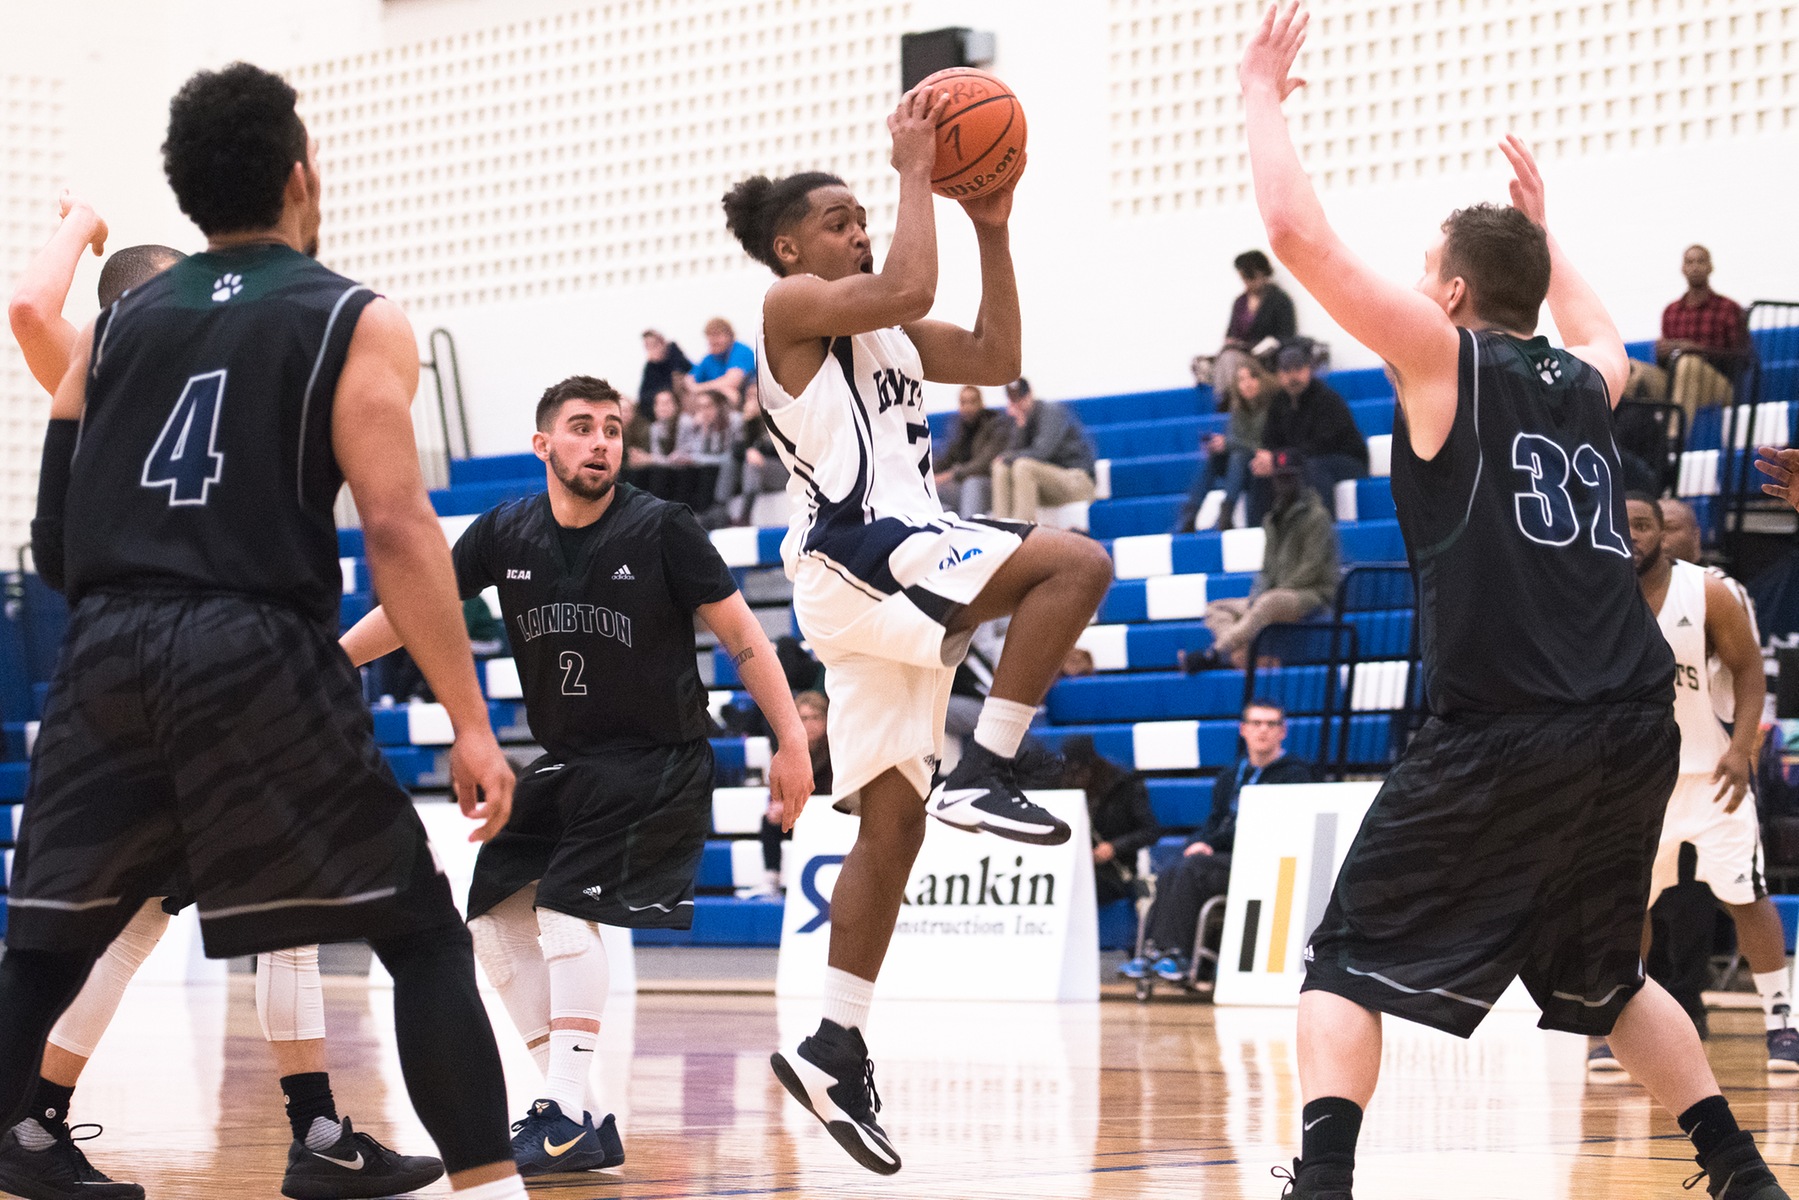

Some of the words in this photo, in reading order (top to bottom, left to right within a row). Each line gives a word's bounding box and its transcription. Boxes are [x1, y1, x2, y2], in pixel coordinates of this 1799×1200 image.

[940, 146, 1018, 197] Wilson
[141, 369, 228, 506] 4
[1512, 431, 1632, 559] 32
[517, 603, 632, 648] LAMBTON
[559, 650, 588, 696] 2
[903, 855, 1055, 906] ankin
[1015, 914, 1053, 936] Inc.
